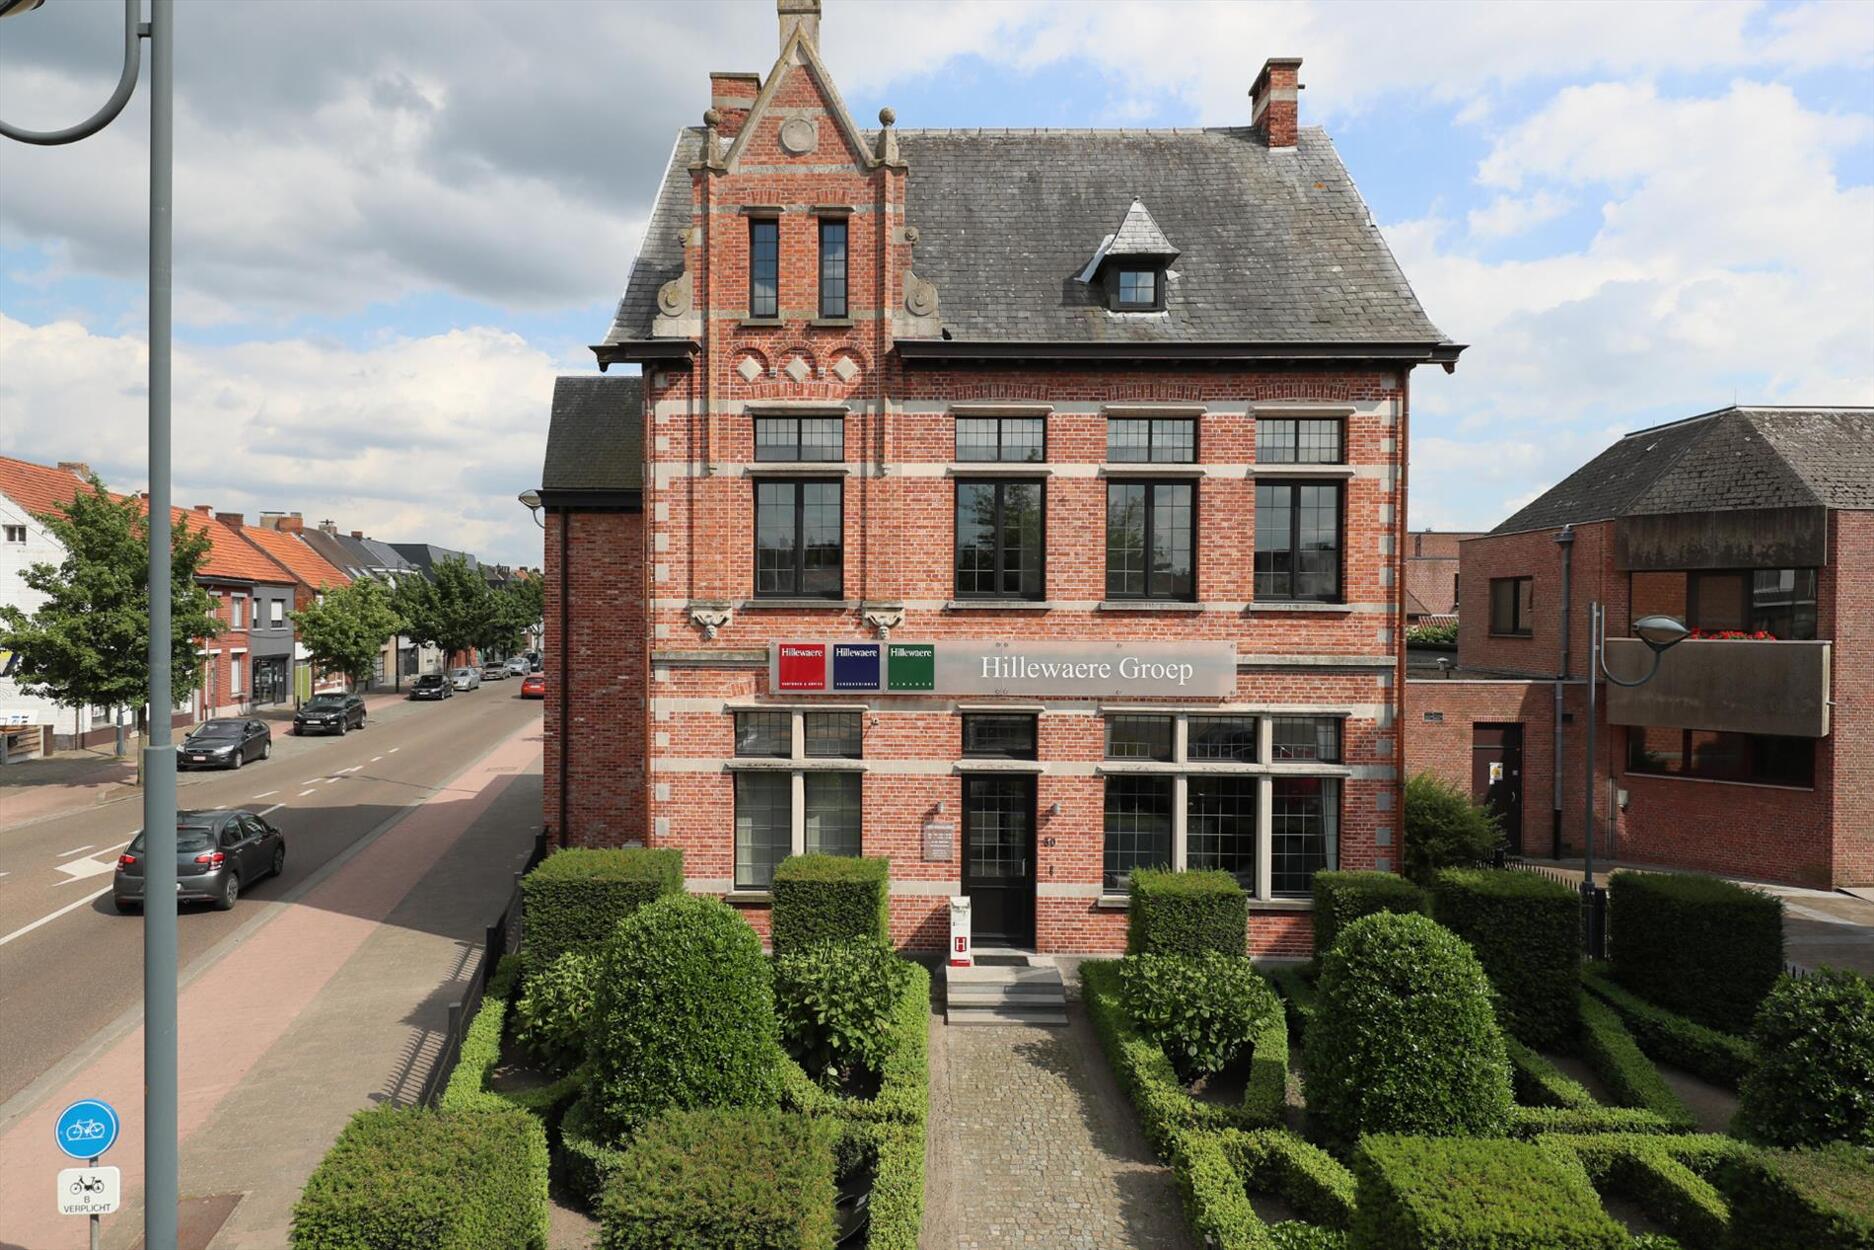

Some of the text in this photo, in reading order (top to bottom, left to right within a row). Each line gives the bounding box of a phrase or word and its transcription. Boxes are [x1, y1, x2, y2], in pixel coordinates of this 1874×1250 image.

[781, 647, 823, 657] Hillewaere
[836, 647, 878, 657] Hillewaere
[890, 647, 932, 657] Hillewaere
[980, 656, 1194, 686] Hillewaere Groep
[64, 1203, 111, 1212] VERPLICHT
